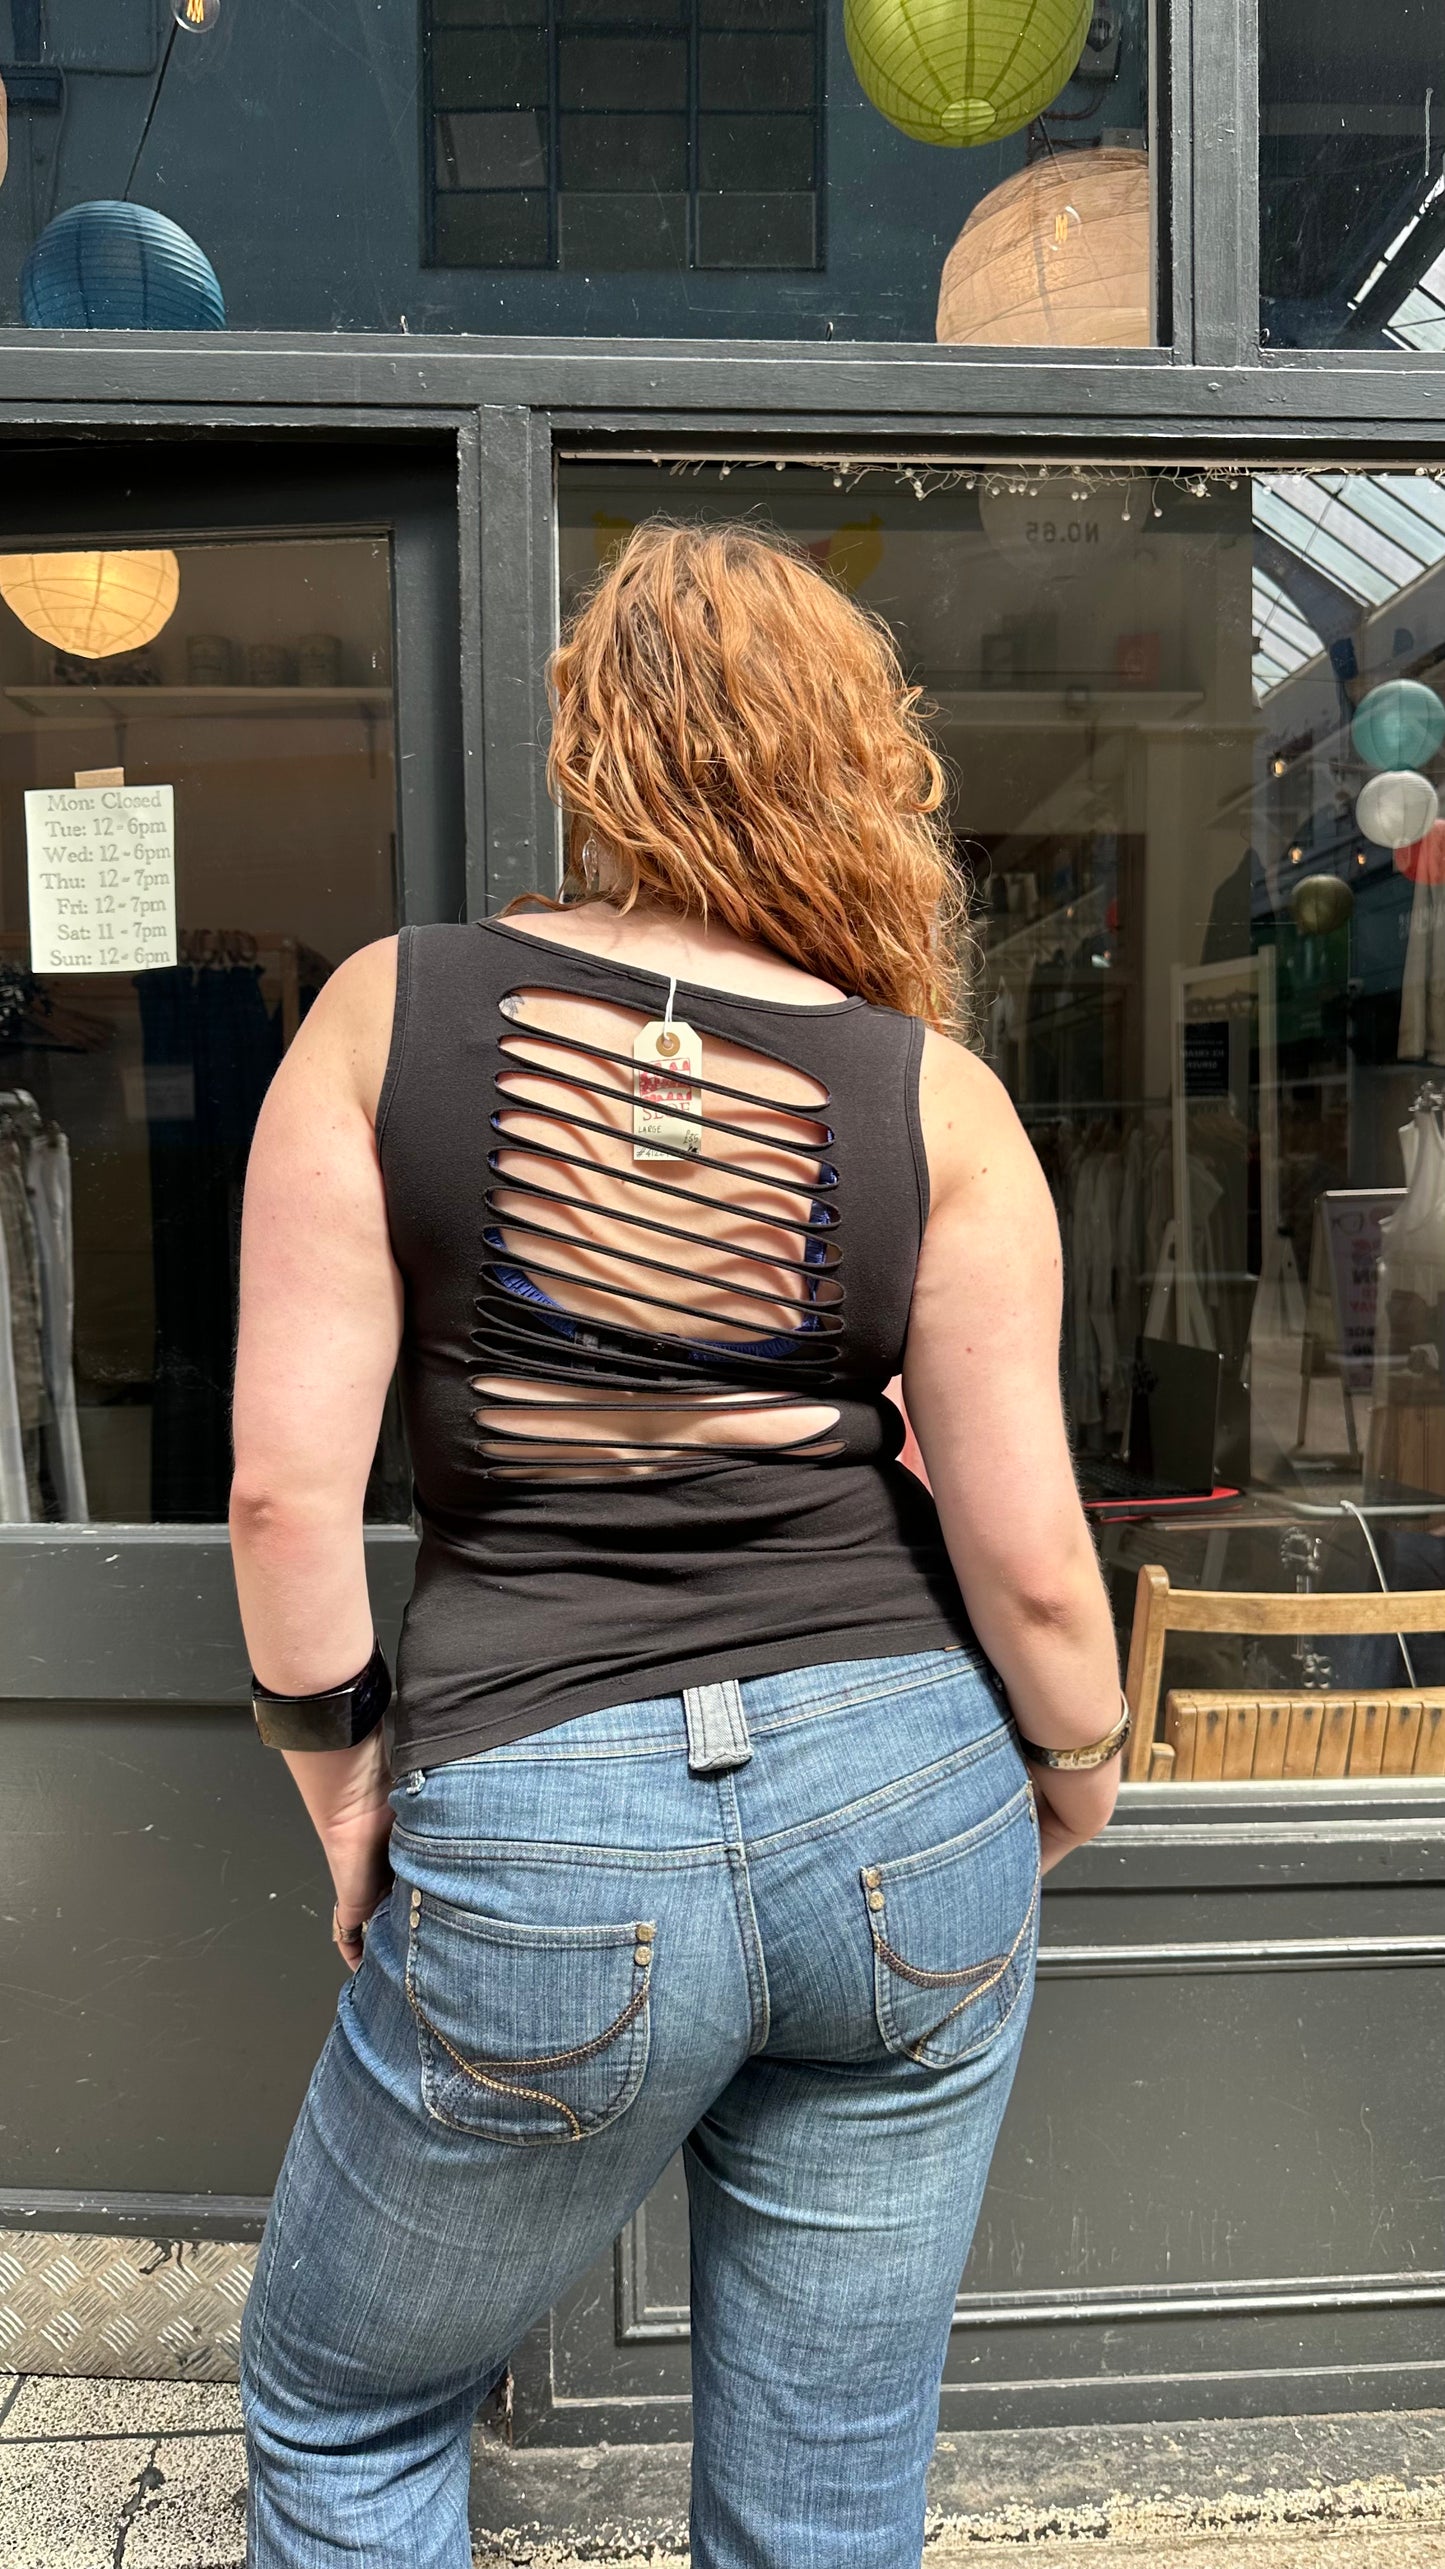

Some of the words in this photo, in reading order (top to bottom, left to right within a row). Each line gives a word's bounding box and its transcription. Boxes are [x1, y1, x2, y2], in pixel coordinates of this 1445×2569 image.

[47, 794, 95, 813] Mon:
[101, 791, 162, 811] Closed
[44, 821, 87, 838] Tue:
[42, 846, 94, 863] Wed:
[39, 872, 86, 890] Thu:
[56, 898, 88, 915] Fri:
[56, 924, 92, 941] Sat:
[50, 950, 92, 966] Sun:
[638, 1125, 662, 1133] LARGE
